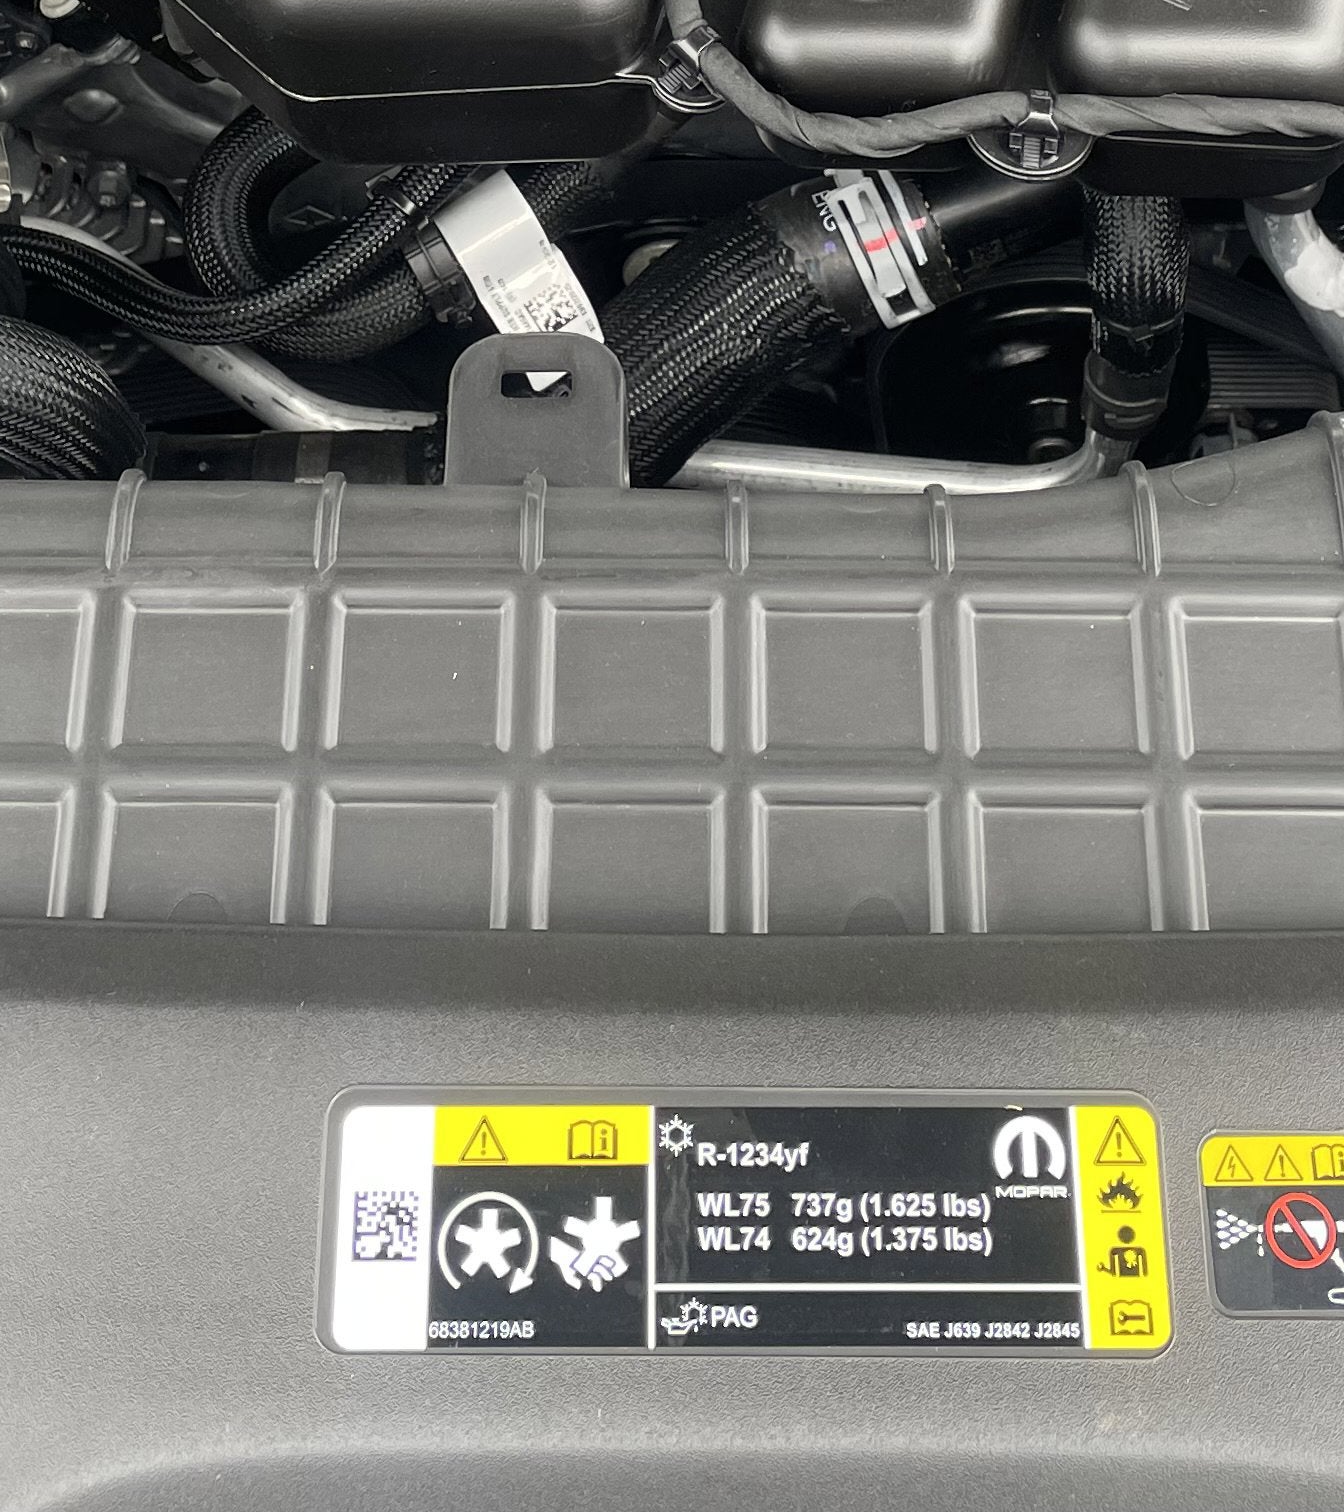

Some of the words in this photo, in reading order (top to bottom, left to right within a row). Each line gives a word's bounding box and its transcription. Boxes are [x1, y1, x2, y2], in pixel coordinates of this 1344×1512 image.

[697, 1141, 810, 1173] R-1234yf
[995, 1185, 1069, 1199] MOPAR
[696, 1192, 771, 1217] WL75
[791, 1192, 854, 1223] 737g
[859, 1192, 937, 1223] (1.625
[942, 1192, 992, 1223] lbs)
[696, 1226, 772, 1251] WL74
[792, 1226, 855, 1257] 624g
[860, 1226, 939, 1257] (1.375
[943, 1226, 993, 1257] lbs)
[427, 1319, 536, 1339] 68381219AB
[710, 1304, 760, 1329] PAG
[906, 1322, 941, 1339] SAE
[943, 1322, 982, 1339] J639
[984, 1322, 1032, 1339] J2842
[1033, 1322, 1081, 1339] J2845
